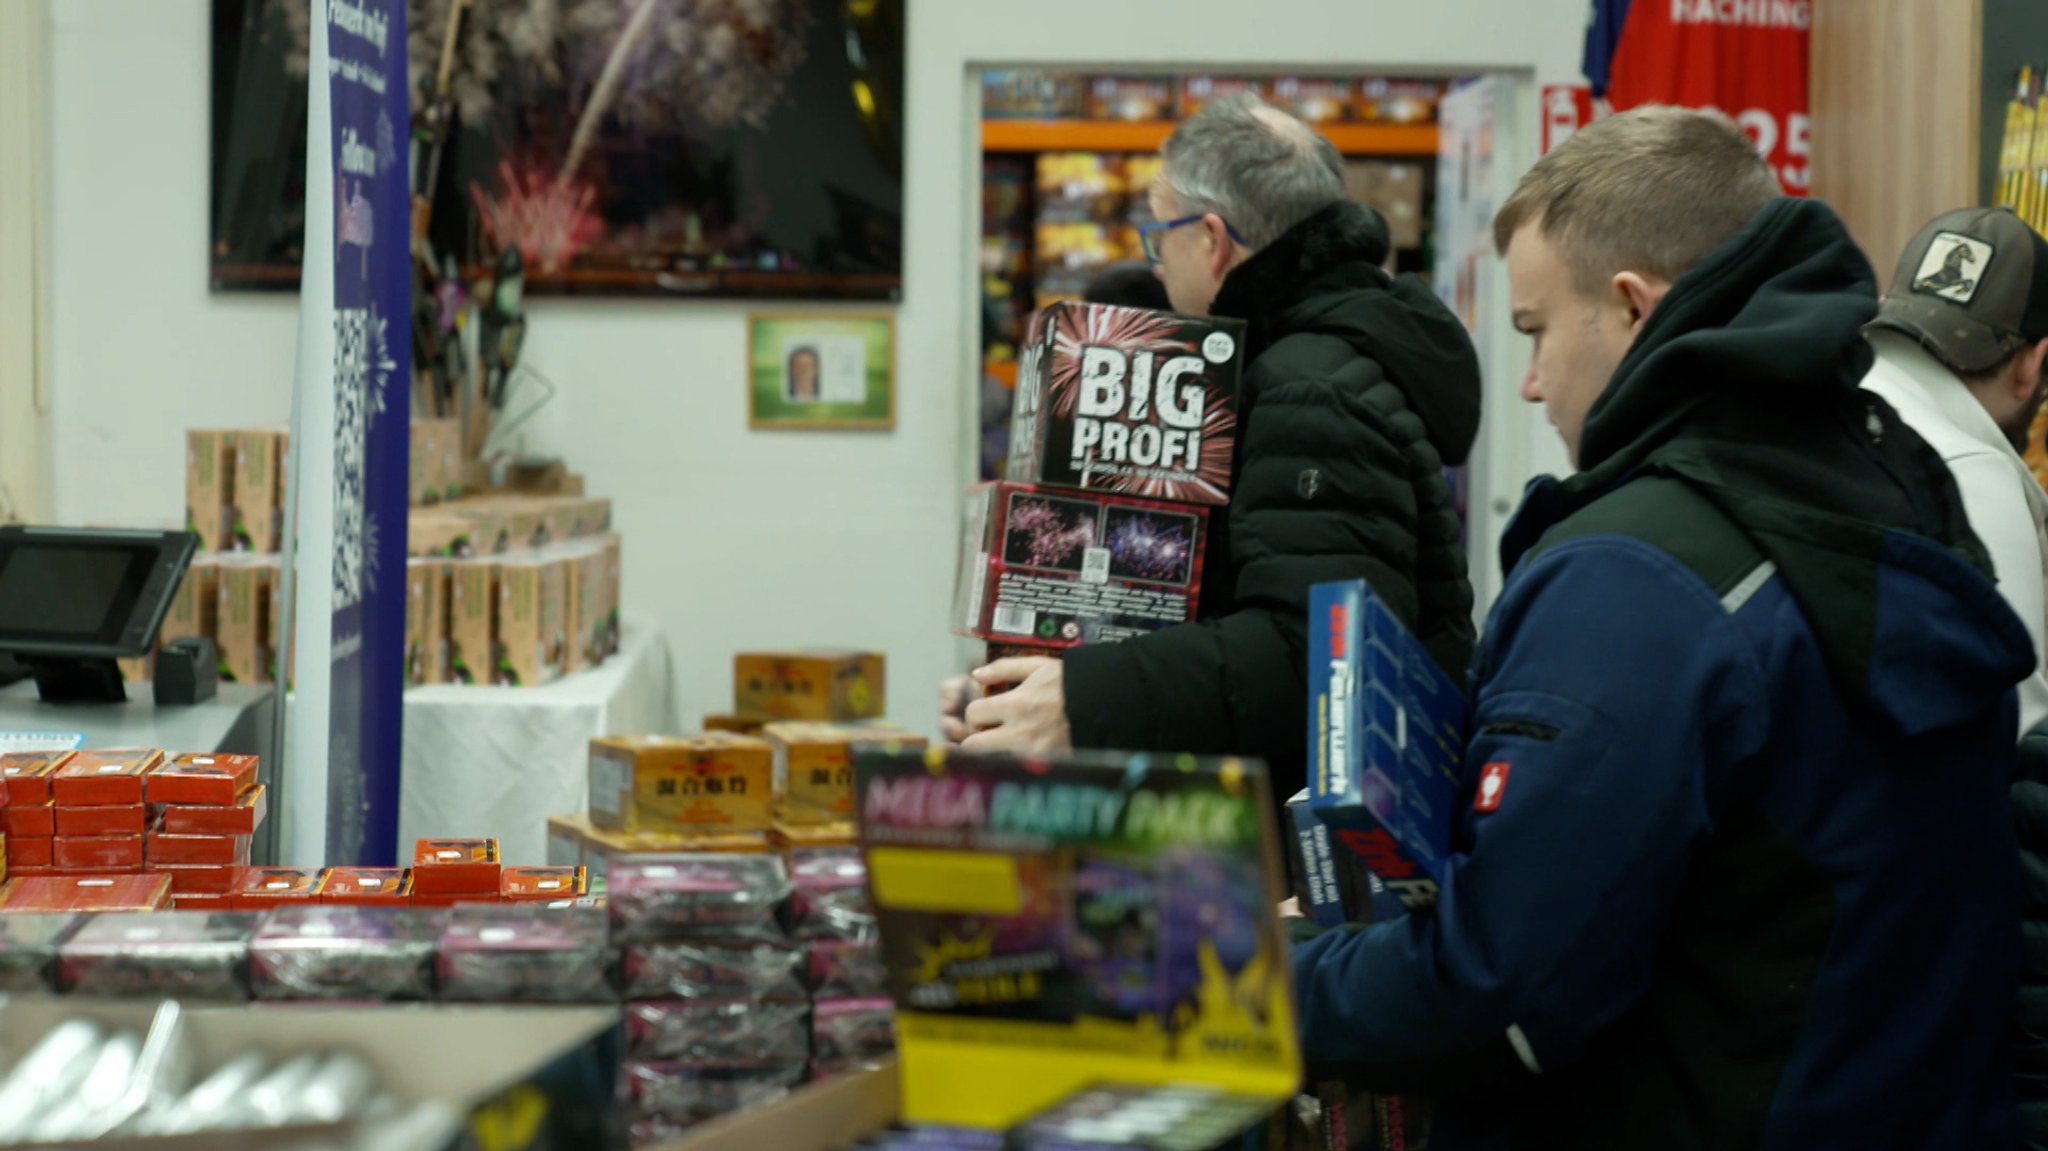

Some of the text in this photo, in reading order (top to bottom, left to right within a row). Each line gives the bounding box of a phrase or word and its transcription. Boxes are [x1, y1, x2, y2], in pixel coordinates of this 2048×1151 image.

[1078, 346, 1205, 429] BIG
[1071, 417, 1201, 472] PROFI
[865, 776, 1245, 843] MEGA PARTY PACK
